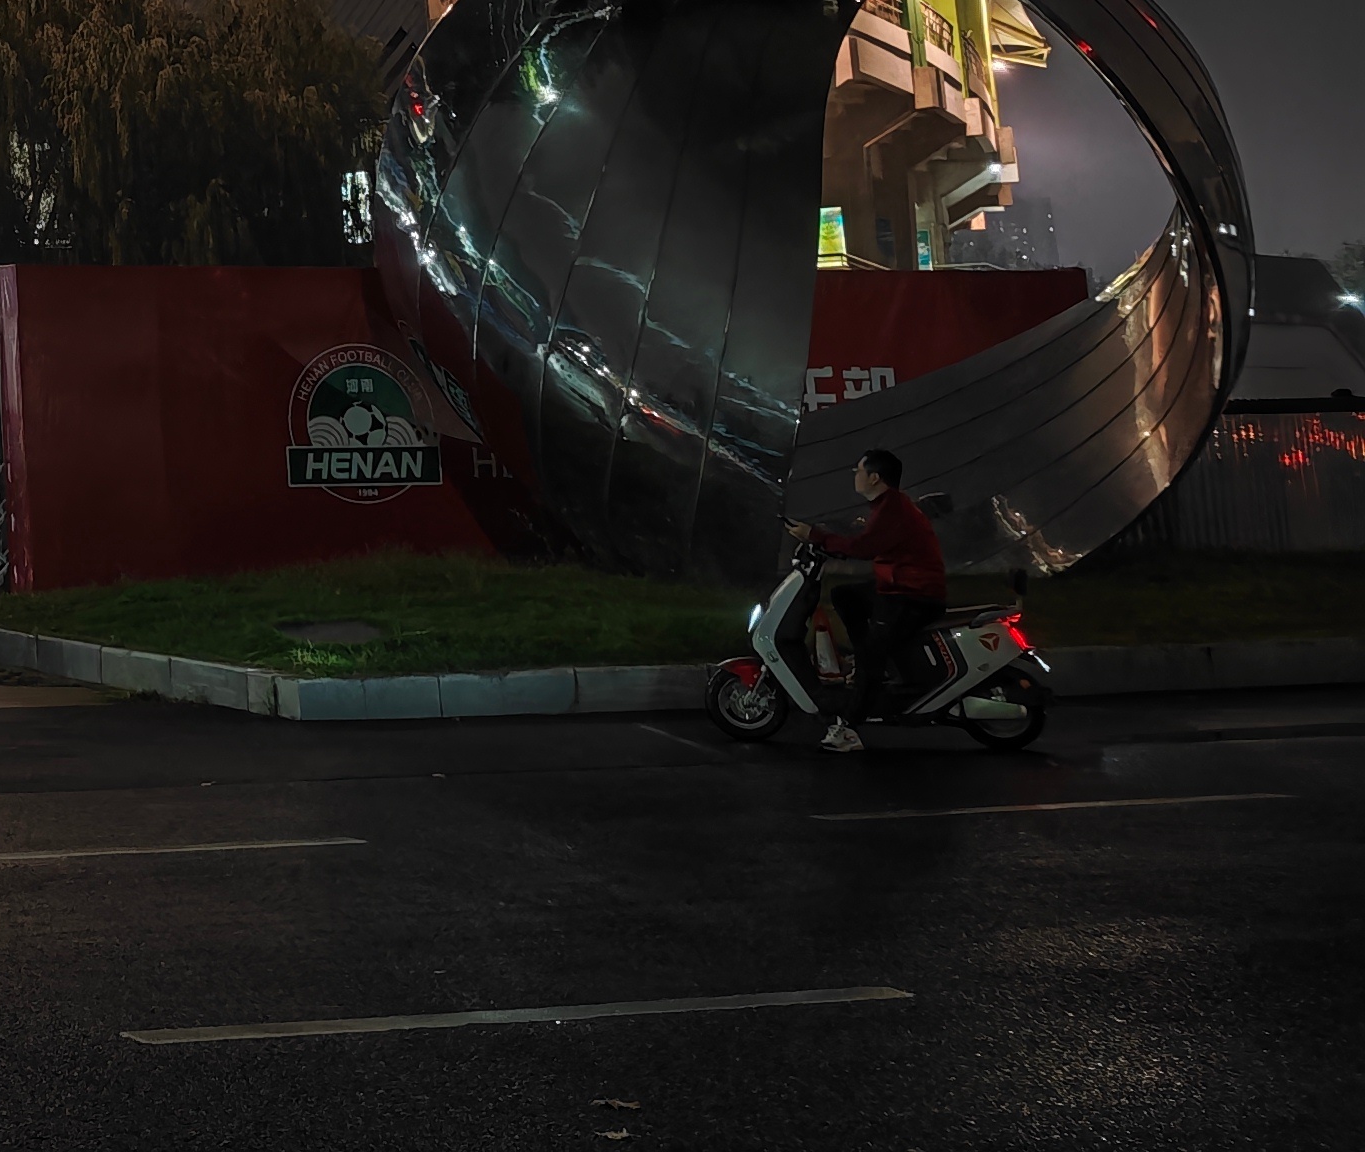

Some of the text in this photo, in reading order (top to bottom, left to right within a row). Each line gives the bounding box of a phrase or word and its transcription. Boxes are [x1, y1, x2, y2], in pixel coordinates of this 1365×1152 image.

[297, 359, 330, 402] HENAN
[330, 349, 396, 373] FOOTBALL
[305, 451, 423, 480] HENAN
